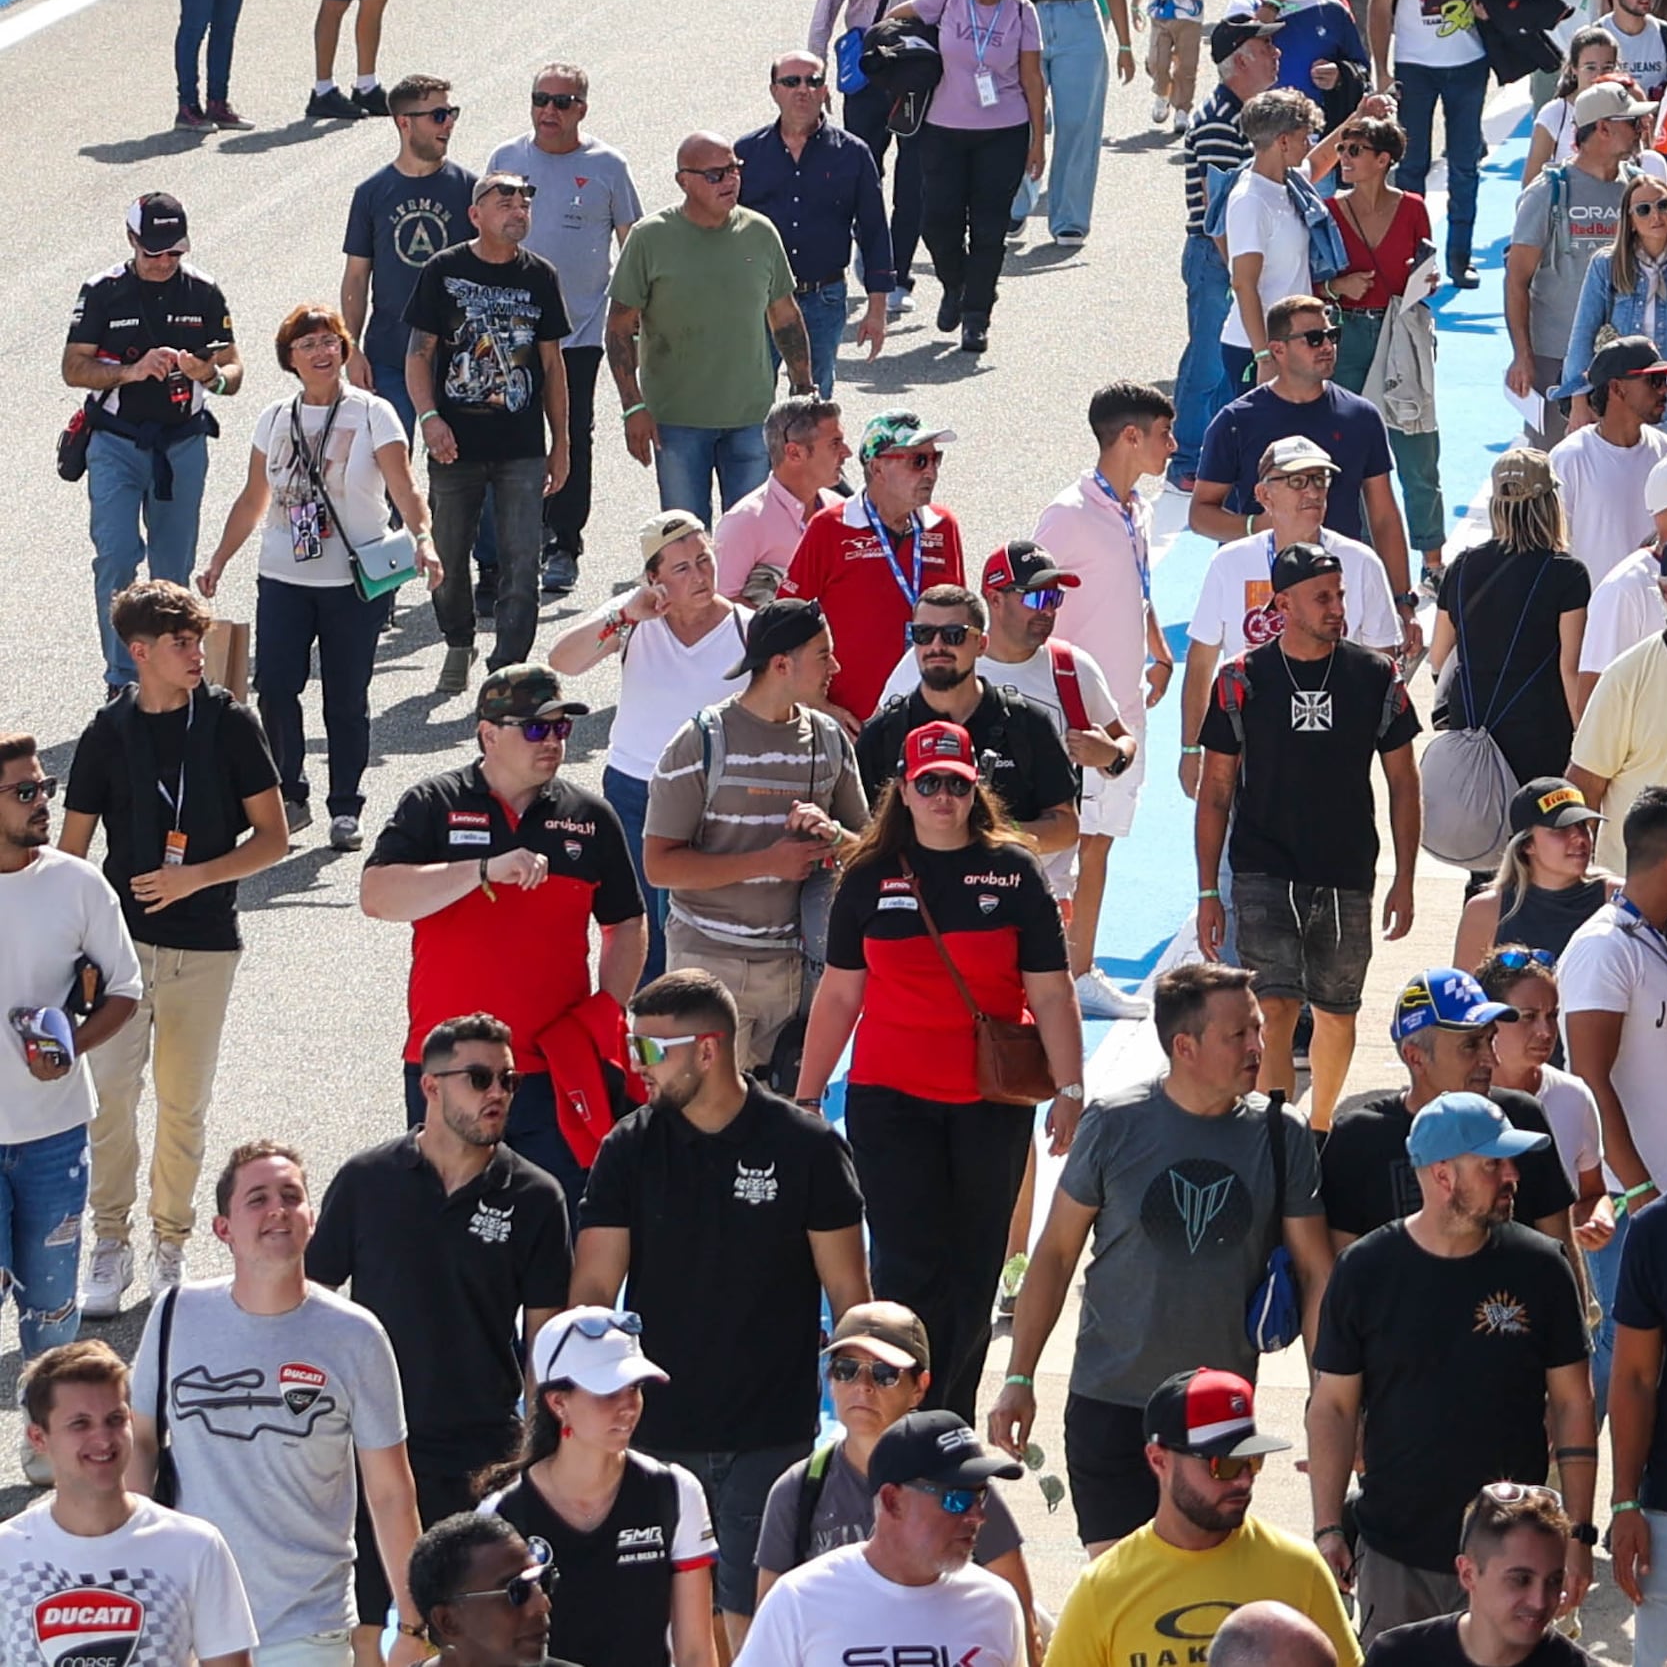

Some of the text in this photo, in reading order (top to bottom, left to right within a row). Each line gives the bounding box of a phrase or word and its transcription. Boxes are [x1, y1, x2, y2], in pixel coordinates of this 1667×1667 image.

[1631, 61, 1662, 73] JEANS
[406, 222, 436, 256] A
[452, 814, 488, 824] Lenovo
[545, 817, 597, 836] aruba.it
[964, 870, 1023, 888] aruba.it
[282, 1367, 323, 1384] DUCATI
[617, 1525, 664, 1547] SMR
[43, 1606, 133, 1627] DUCATI
